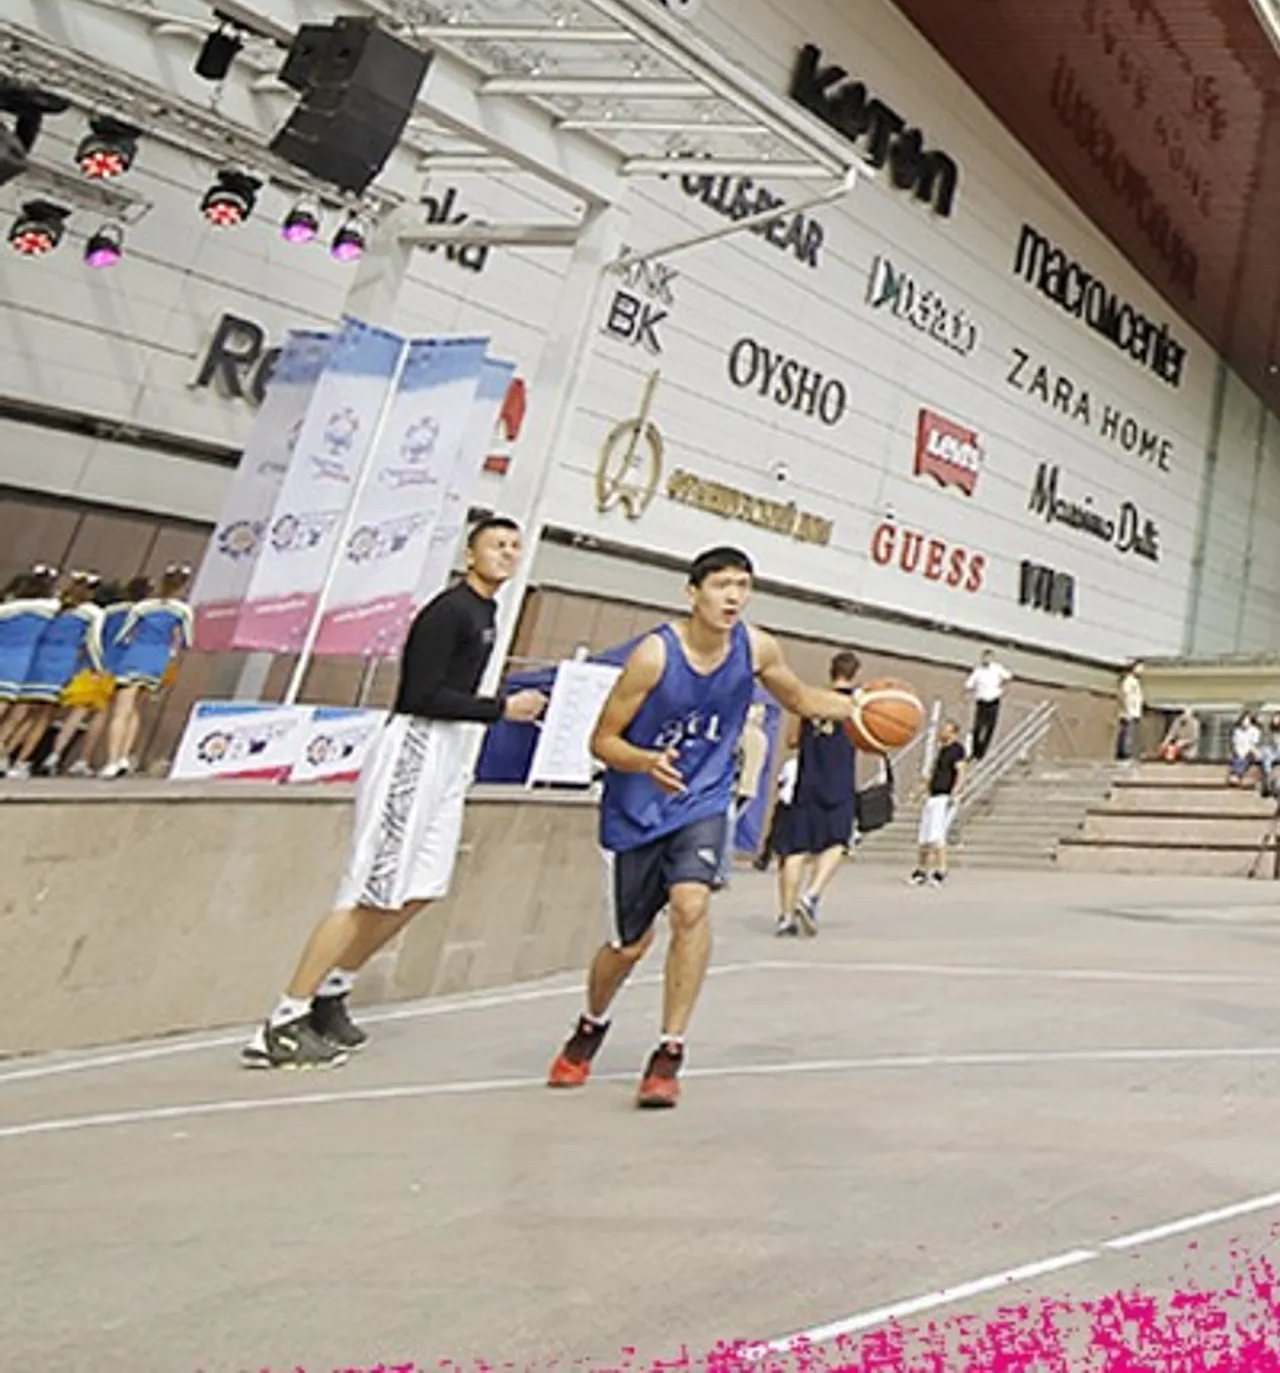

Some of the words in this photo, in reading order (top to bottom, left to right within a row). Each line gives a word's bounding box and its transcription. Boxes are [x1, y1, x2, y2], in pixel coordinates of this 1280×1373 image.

[727, 337, 848, 426] OYSHO
[1005, 347, 1091, 425] ZARA
[1100, 405, 1175, 473] HOME
[871, 522, 987, 594] GUESS
